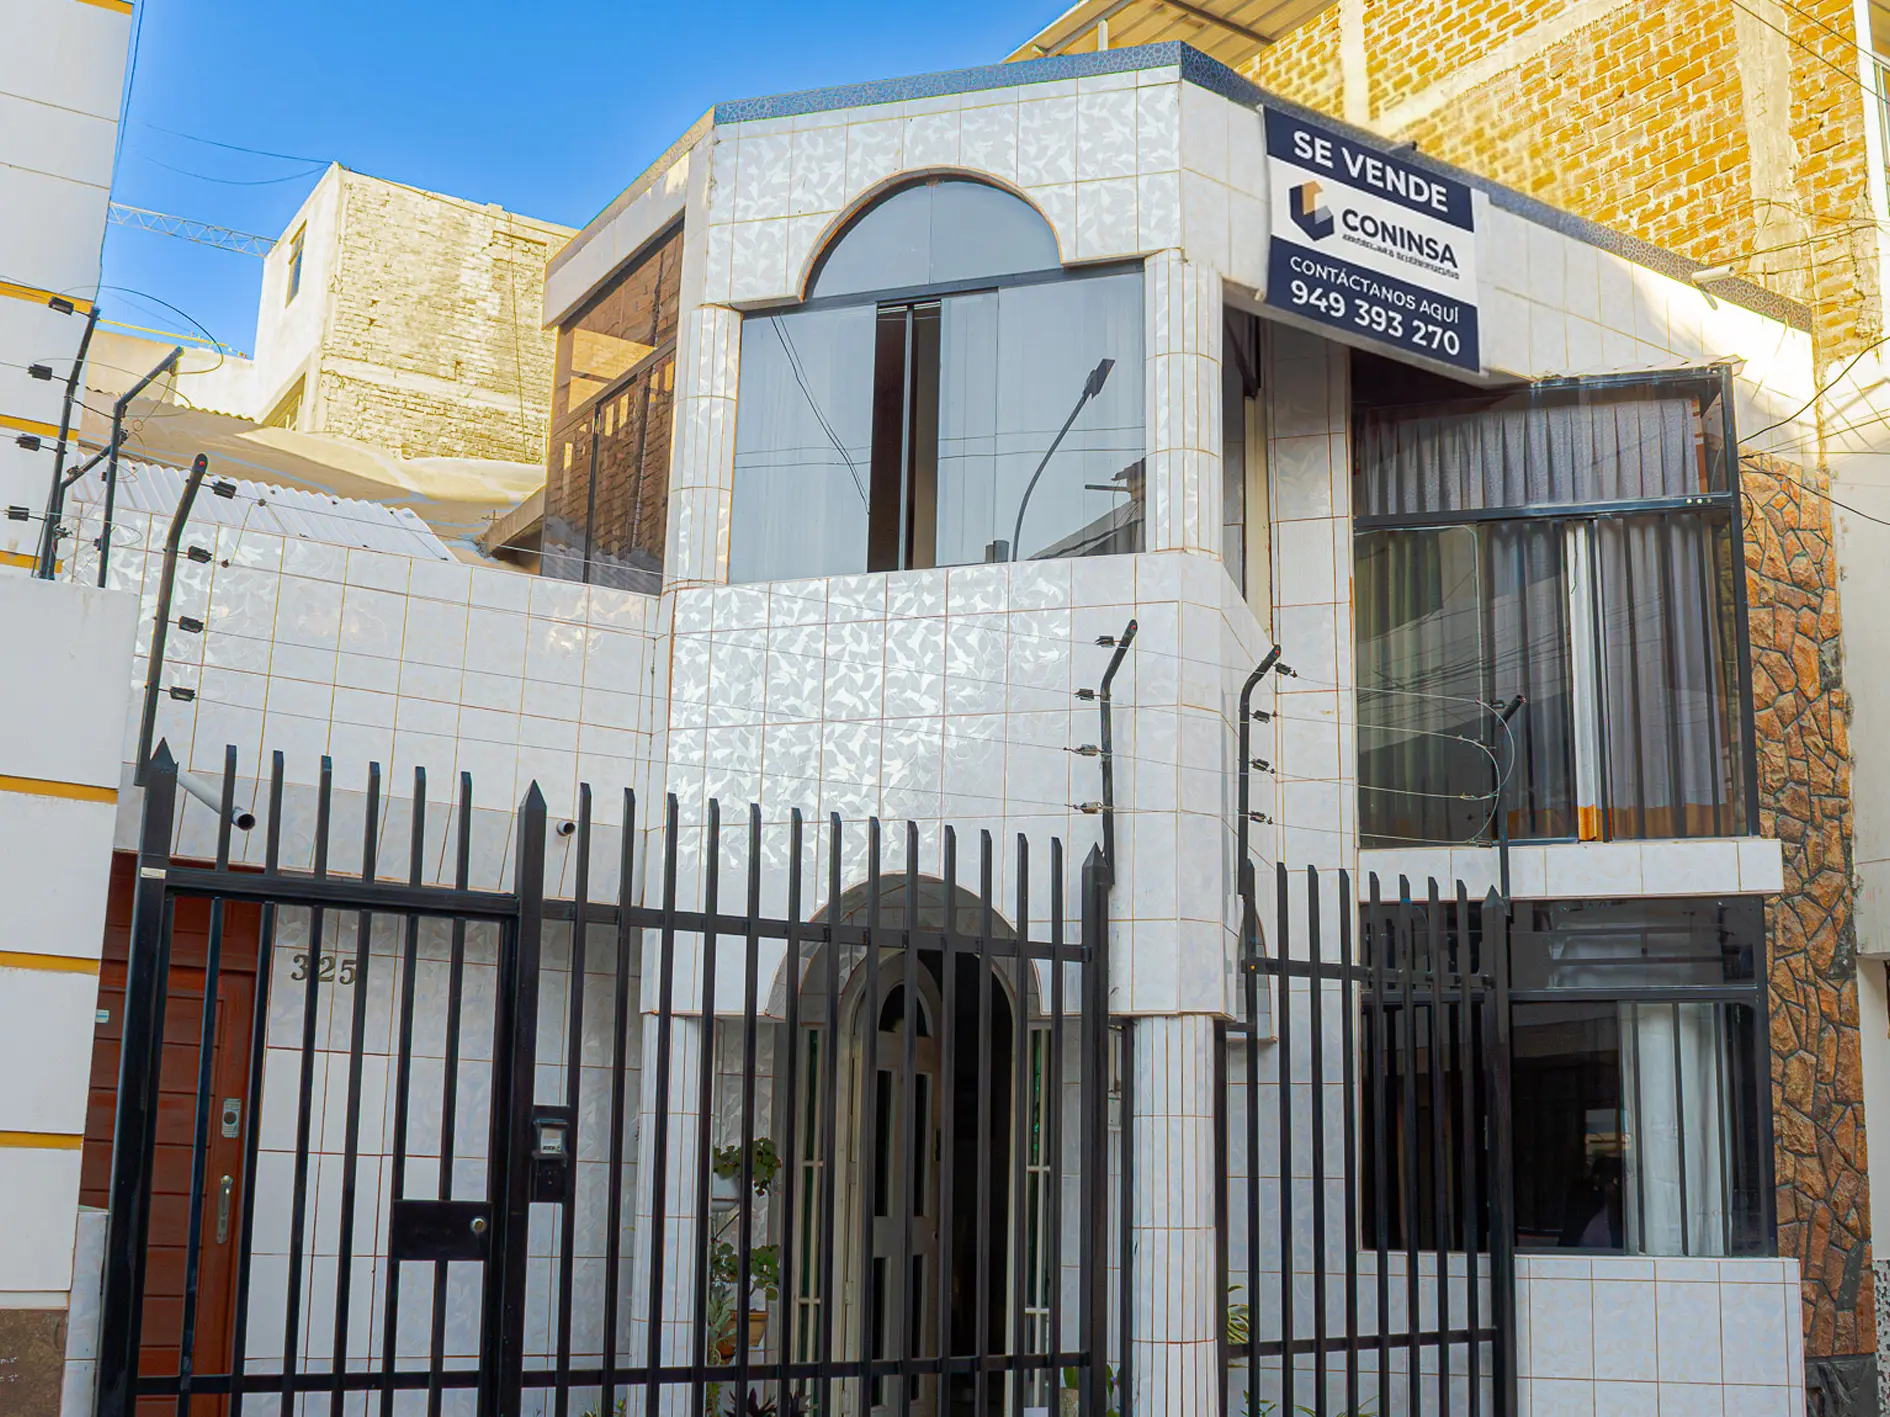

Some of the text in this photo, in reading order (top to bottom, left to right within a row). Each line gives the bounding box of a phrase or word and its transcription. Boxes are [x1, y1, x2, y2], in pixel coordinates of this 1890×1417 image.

[1293, 130, 1449, 213] SE VENDE
[1342, 208, 1459, 269] CONINSA
[1290, 256, 1416, 310] CONTÁCTANOS
[1419, 299, 1459, 324] AQUÍ
[1290, 280, 1460, 356] 949 393 270
[291, 954, 358, 985] 325
